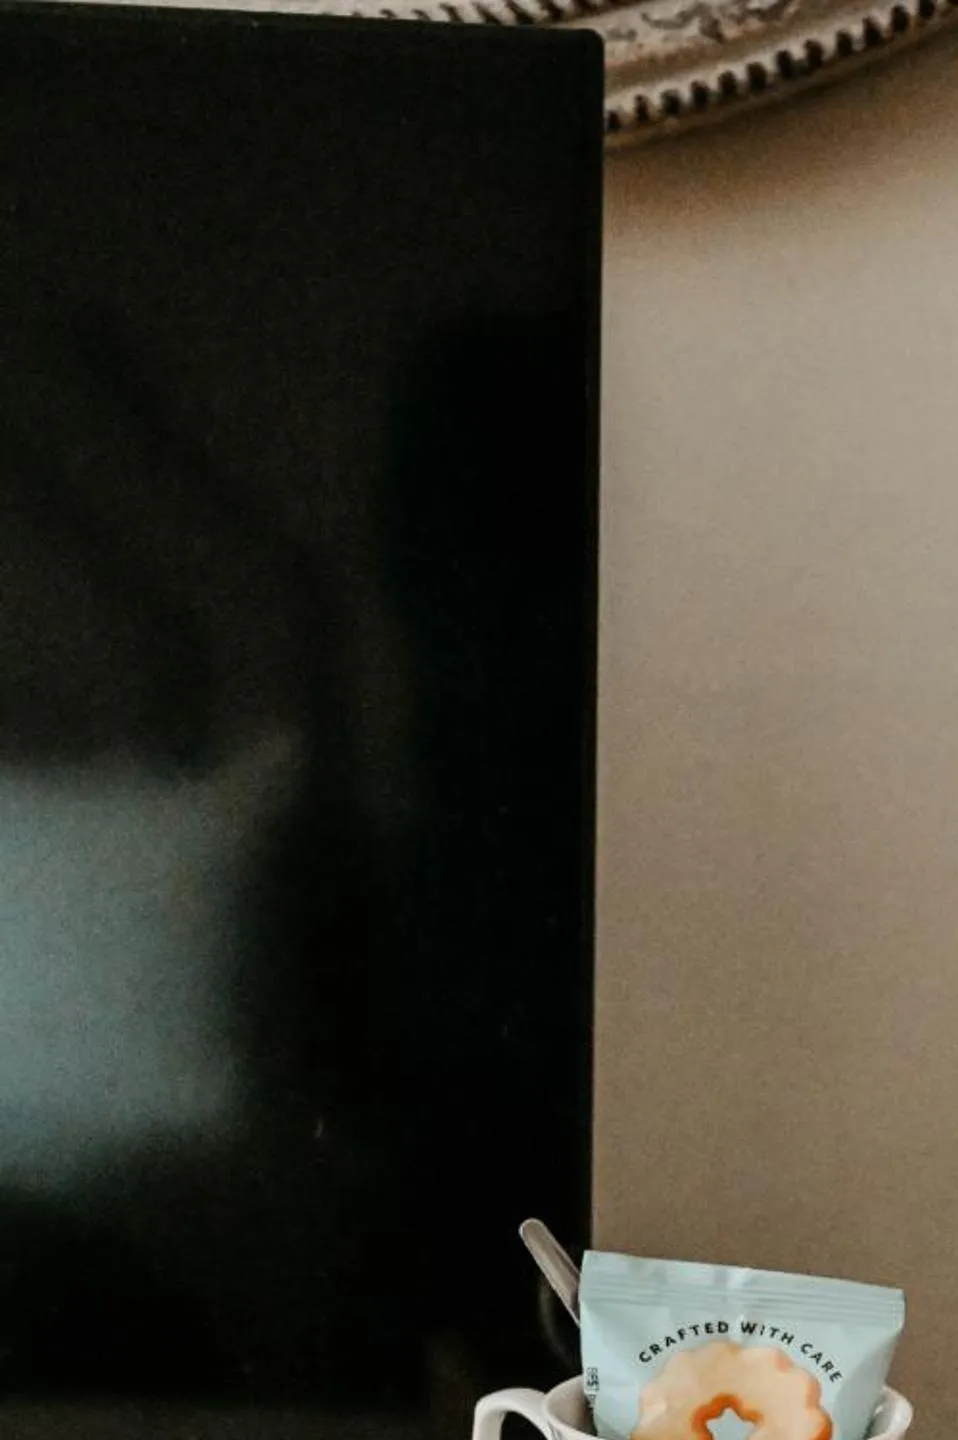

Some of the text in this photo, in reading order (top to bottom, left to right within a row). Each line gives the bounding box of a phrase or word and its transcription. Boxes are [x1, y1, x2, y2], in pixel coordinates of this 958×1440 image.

[638, 1320, 843, 1383] CRAFTED WITH CARE
